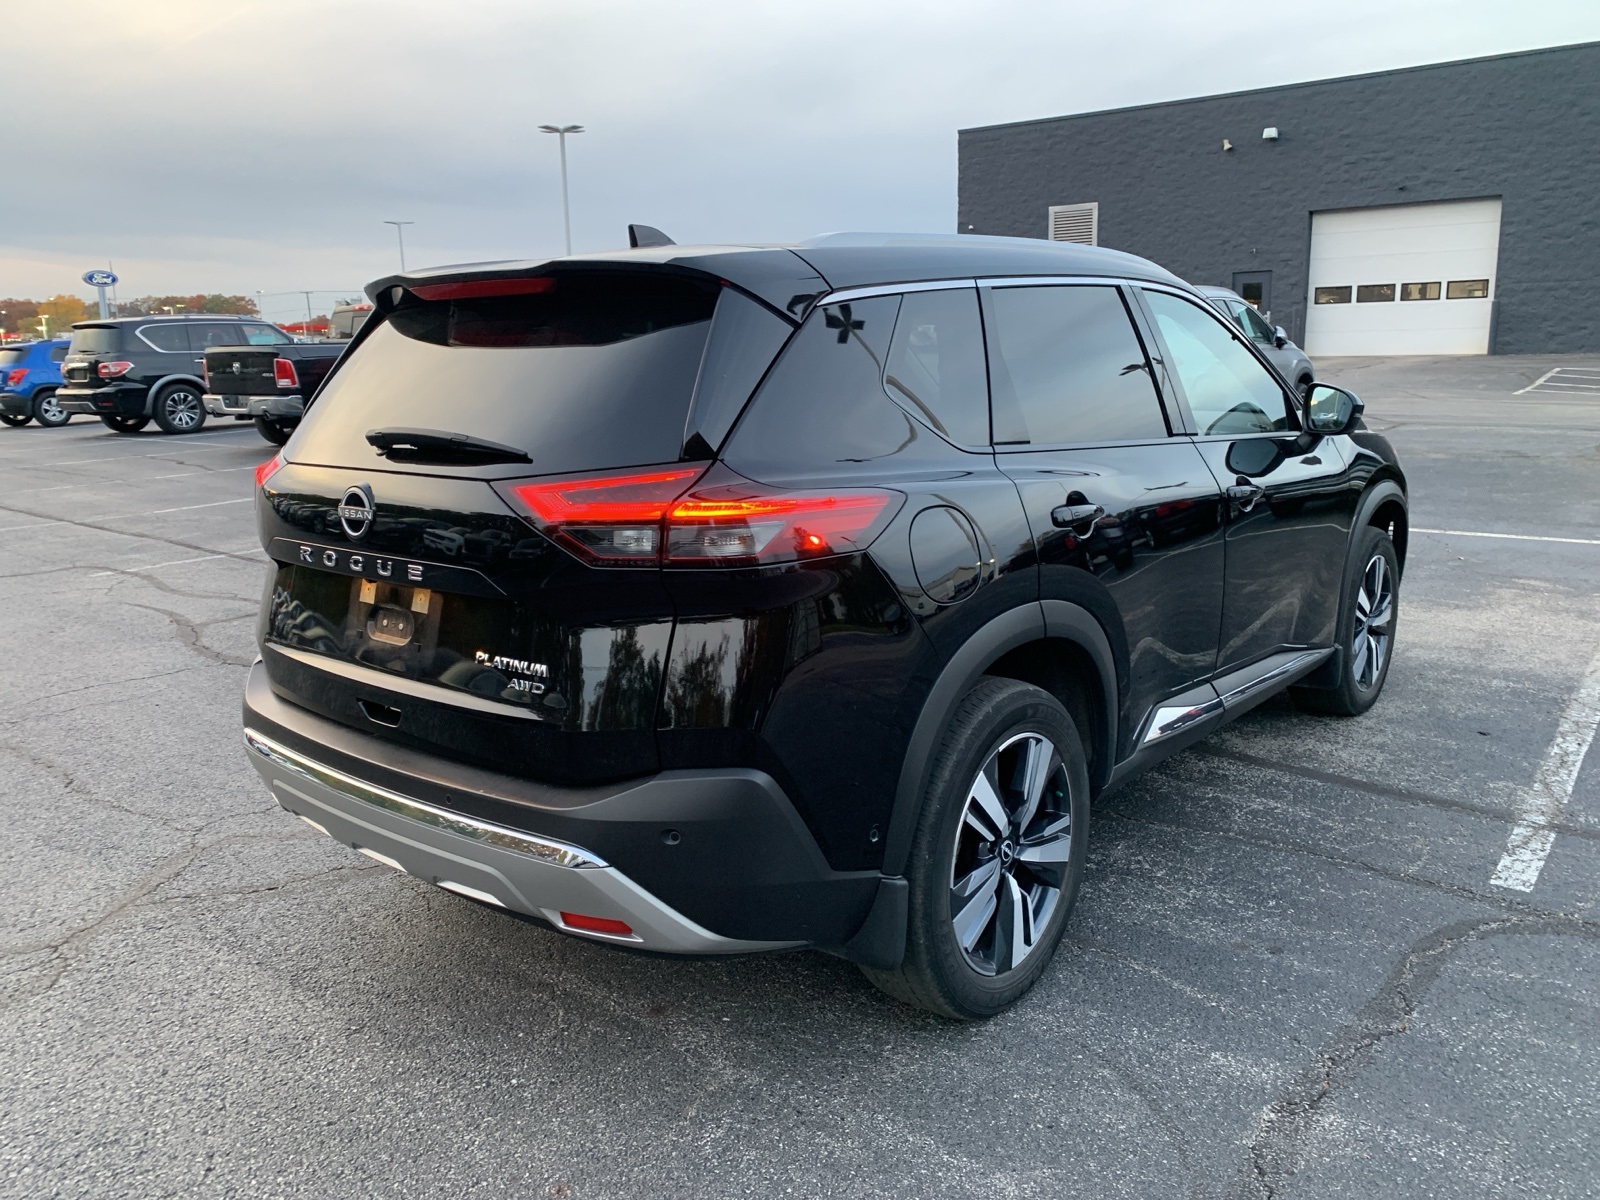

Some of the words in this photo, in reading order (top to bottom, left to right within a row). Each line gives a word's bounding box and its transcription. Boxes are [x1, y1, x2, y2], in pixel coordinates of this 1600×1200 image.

[92, 273, 112, 284] Ford
[339, 507, 372, 520] NISSAN
[300, 546, 423, 581] ROGUE
[475, 651, 549, 678] PLATINUM
[507, 678, 545, 695] AWD
